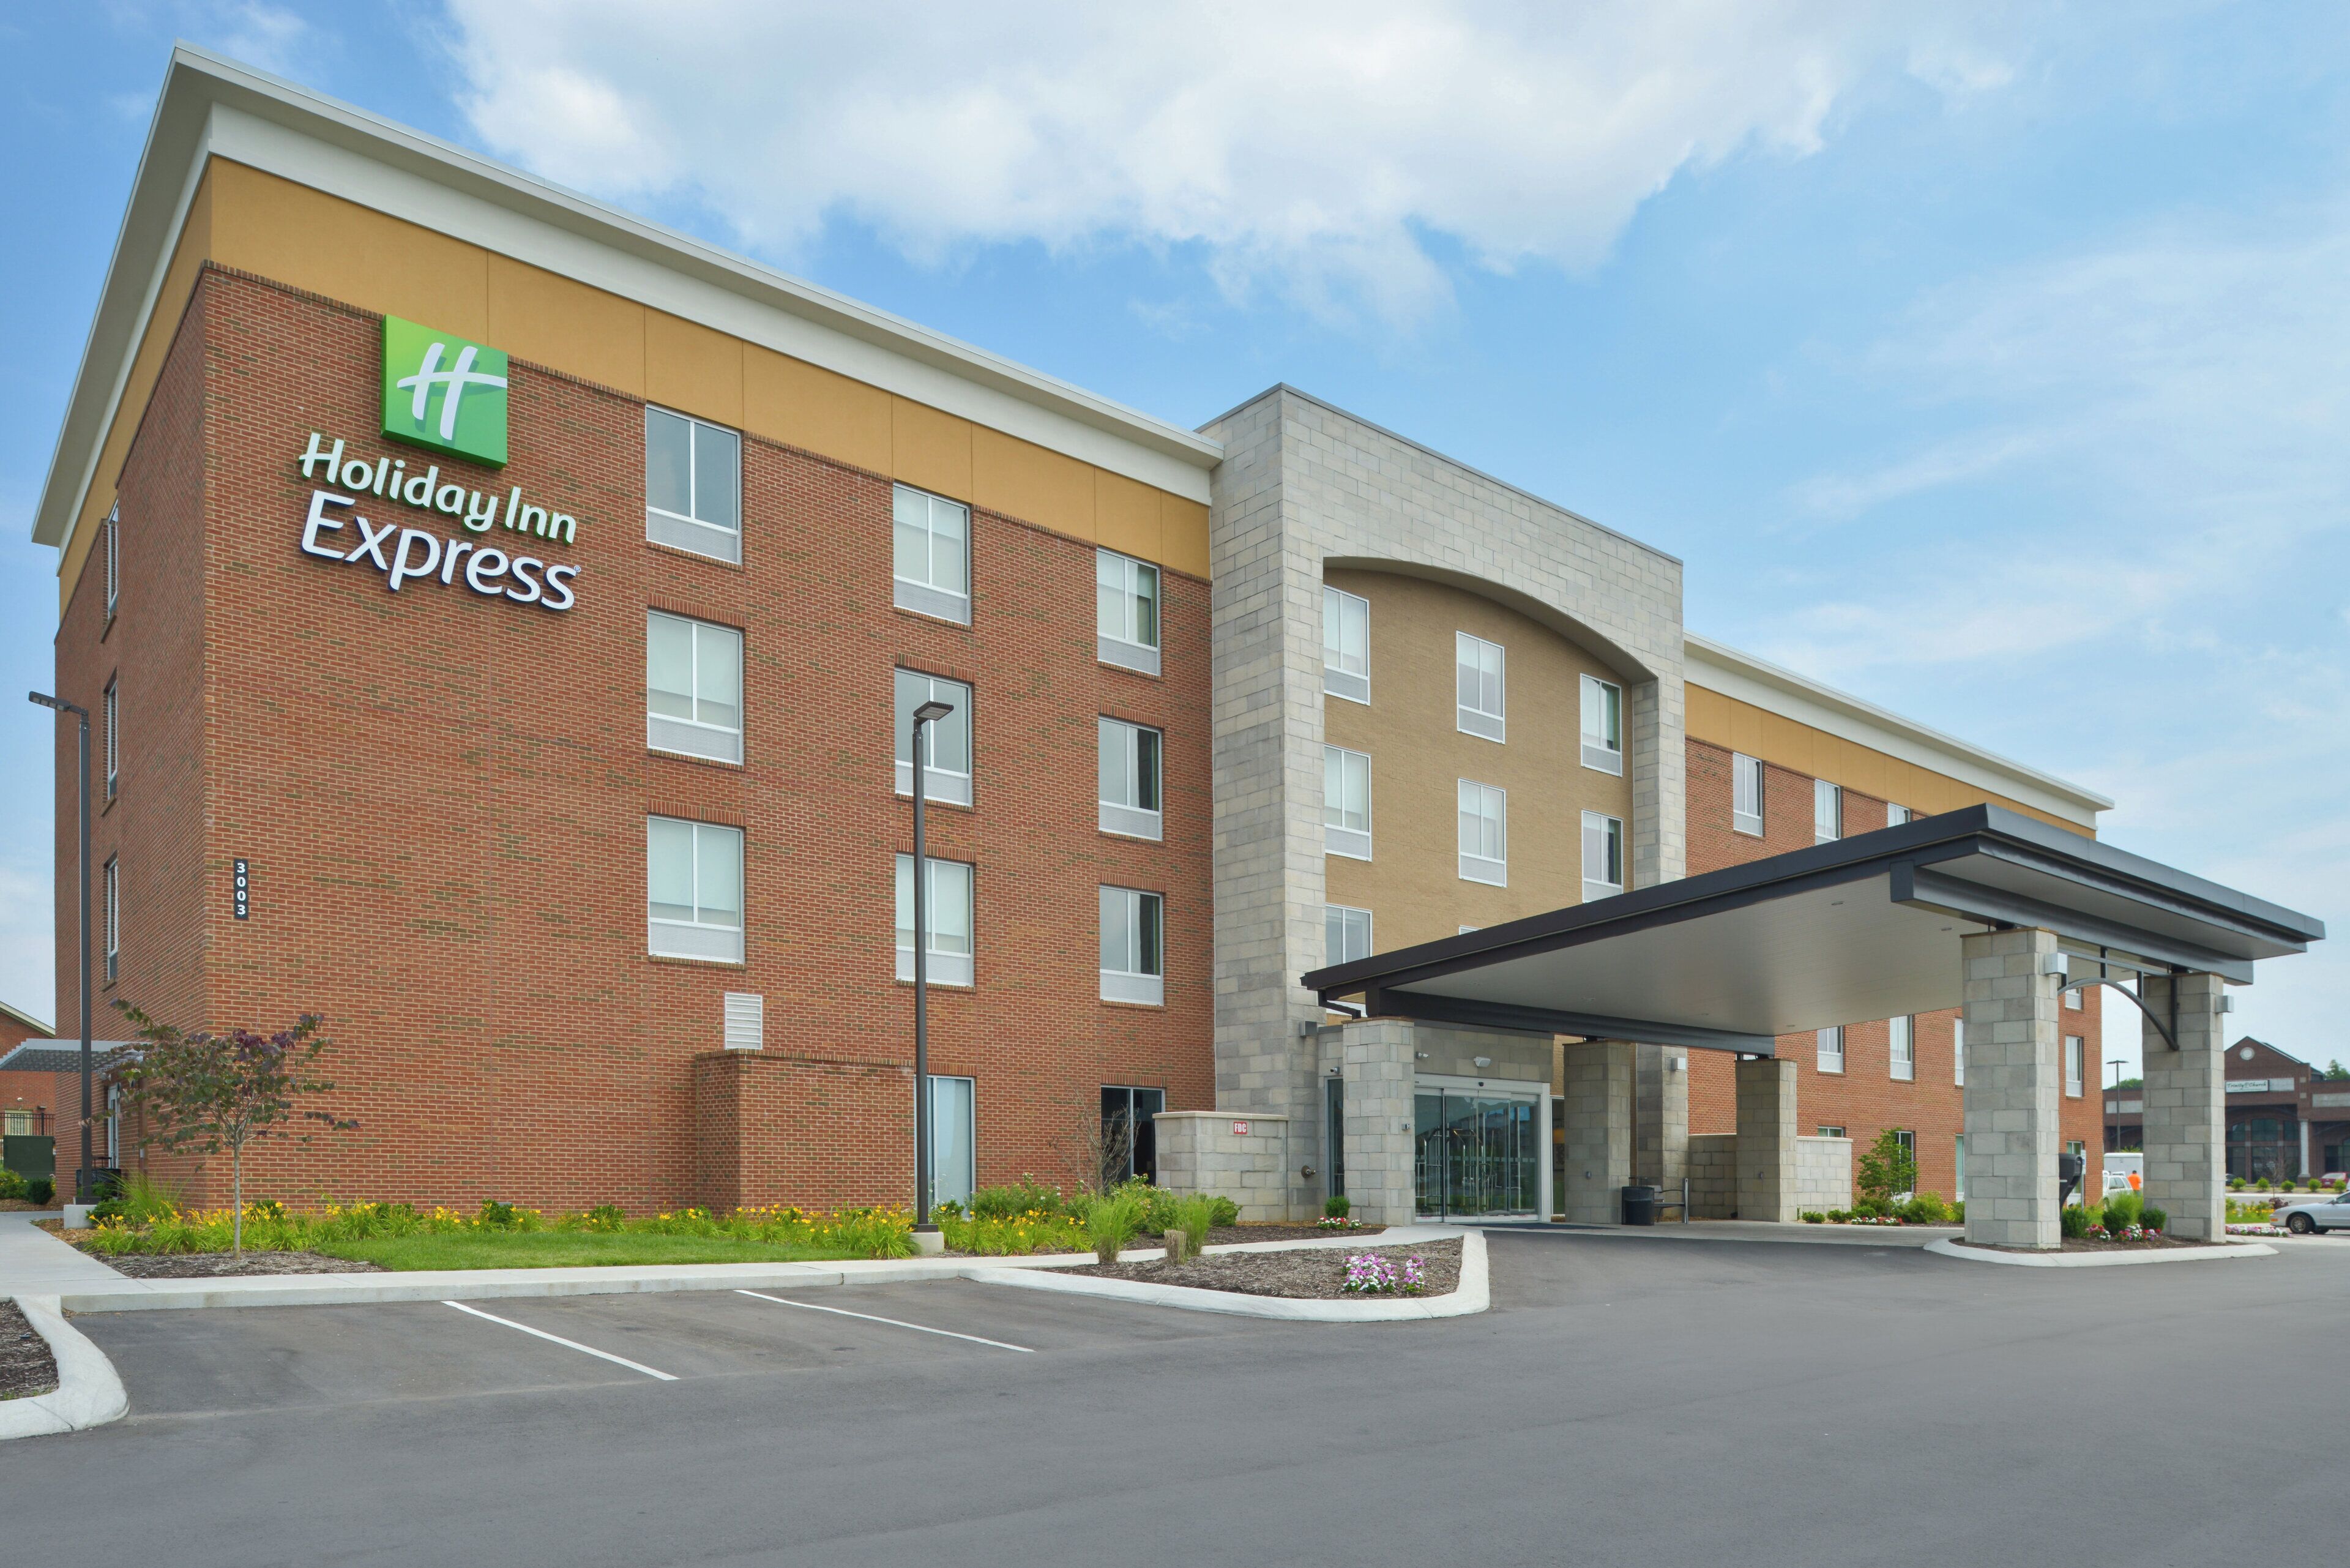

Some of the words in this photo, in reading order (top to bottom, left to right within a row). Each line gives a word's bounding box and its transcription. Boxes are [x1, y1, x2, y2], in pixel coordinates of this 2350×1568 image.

[397, 342, 507, 440] H
[298, 432, 498, 532] Holiday
[504, 486, 577, 545] Inn
[300, 489, 577, 611] Express
[237, 862, 246, 915] 3003
[1234, 1123, 1247, 1132] FDC
